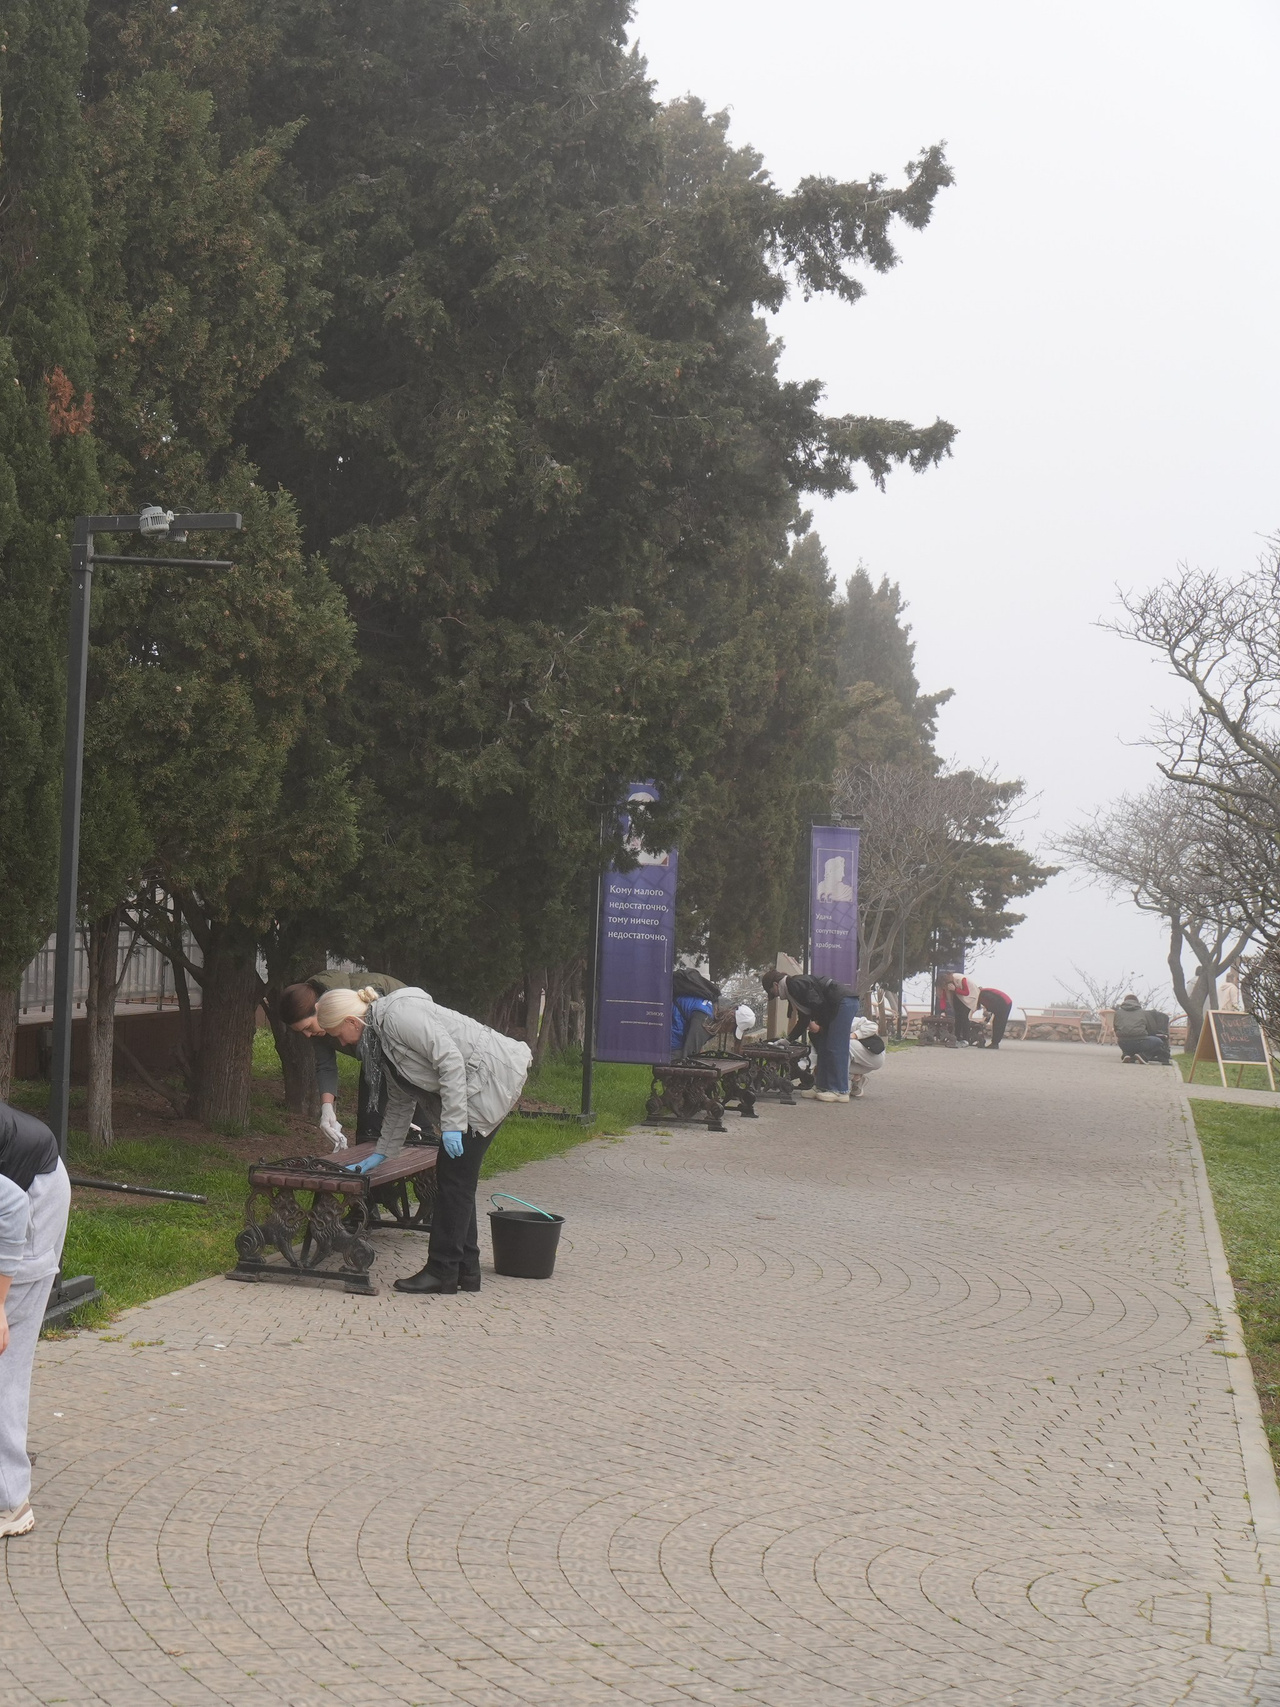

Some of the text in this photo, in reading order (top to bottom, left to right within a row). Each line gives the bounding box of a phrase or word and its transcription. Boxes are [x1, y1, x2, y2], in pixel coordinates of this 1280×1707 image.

[610, 884, 664, 897] Кому малого
[609, 901, 669, 913] недостаточно,
[608, 916, 659, 926] тому ничего
[608, 931, 668, 942] недостаточно.
